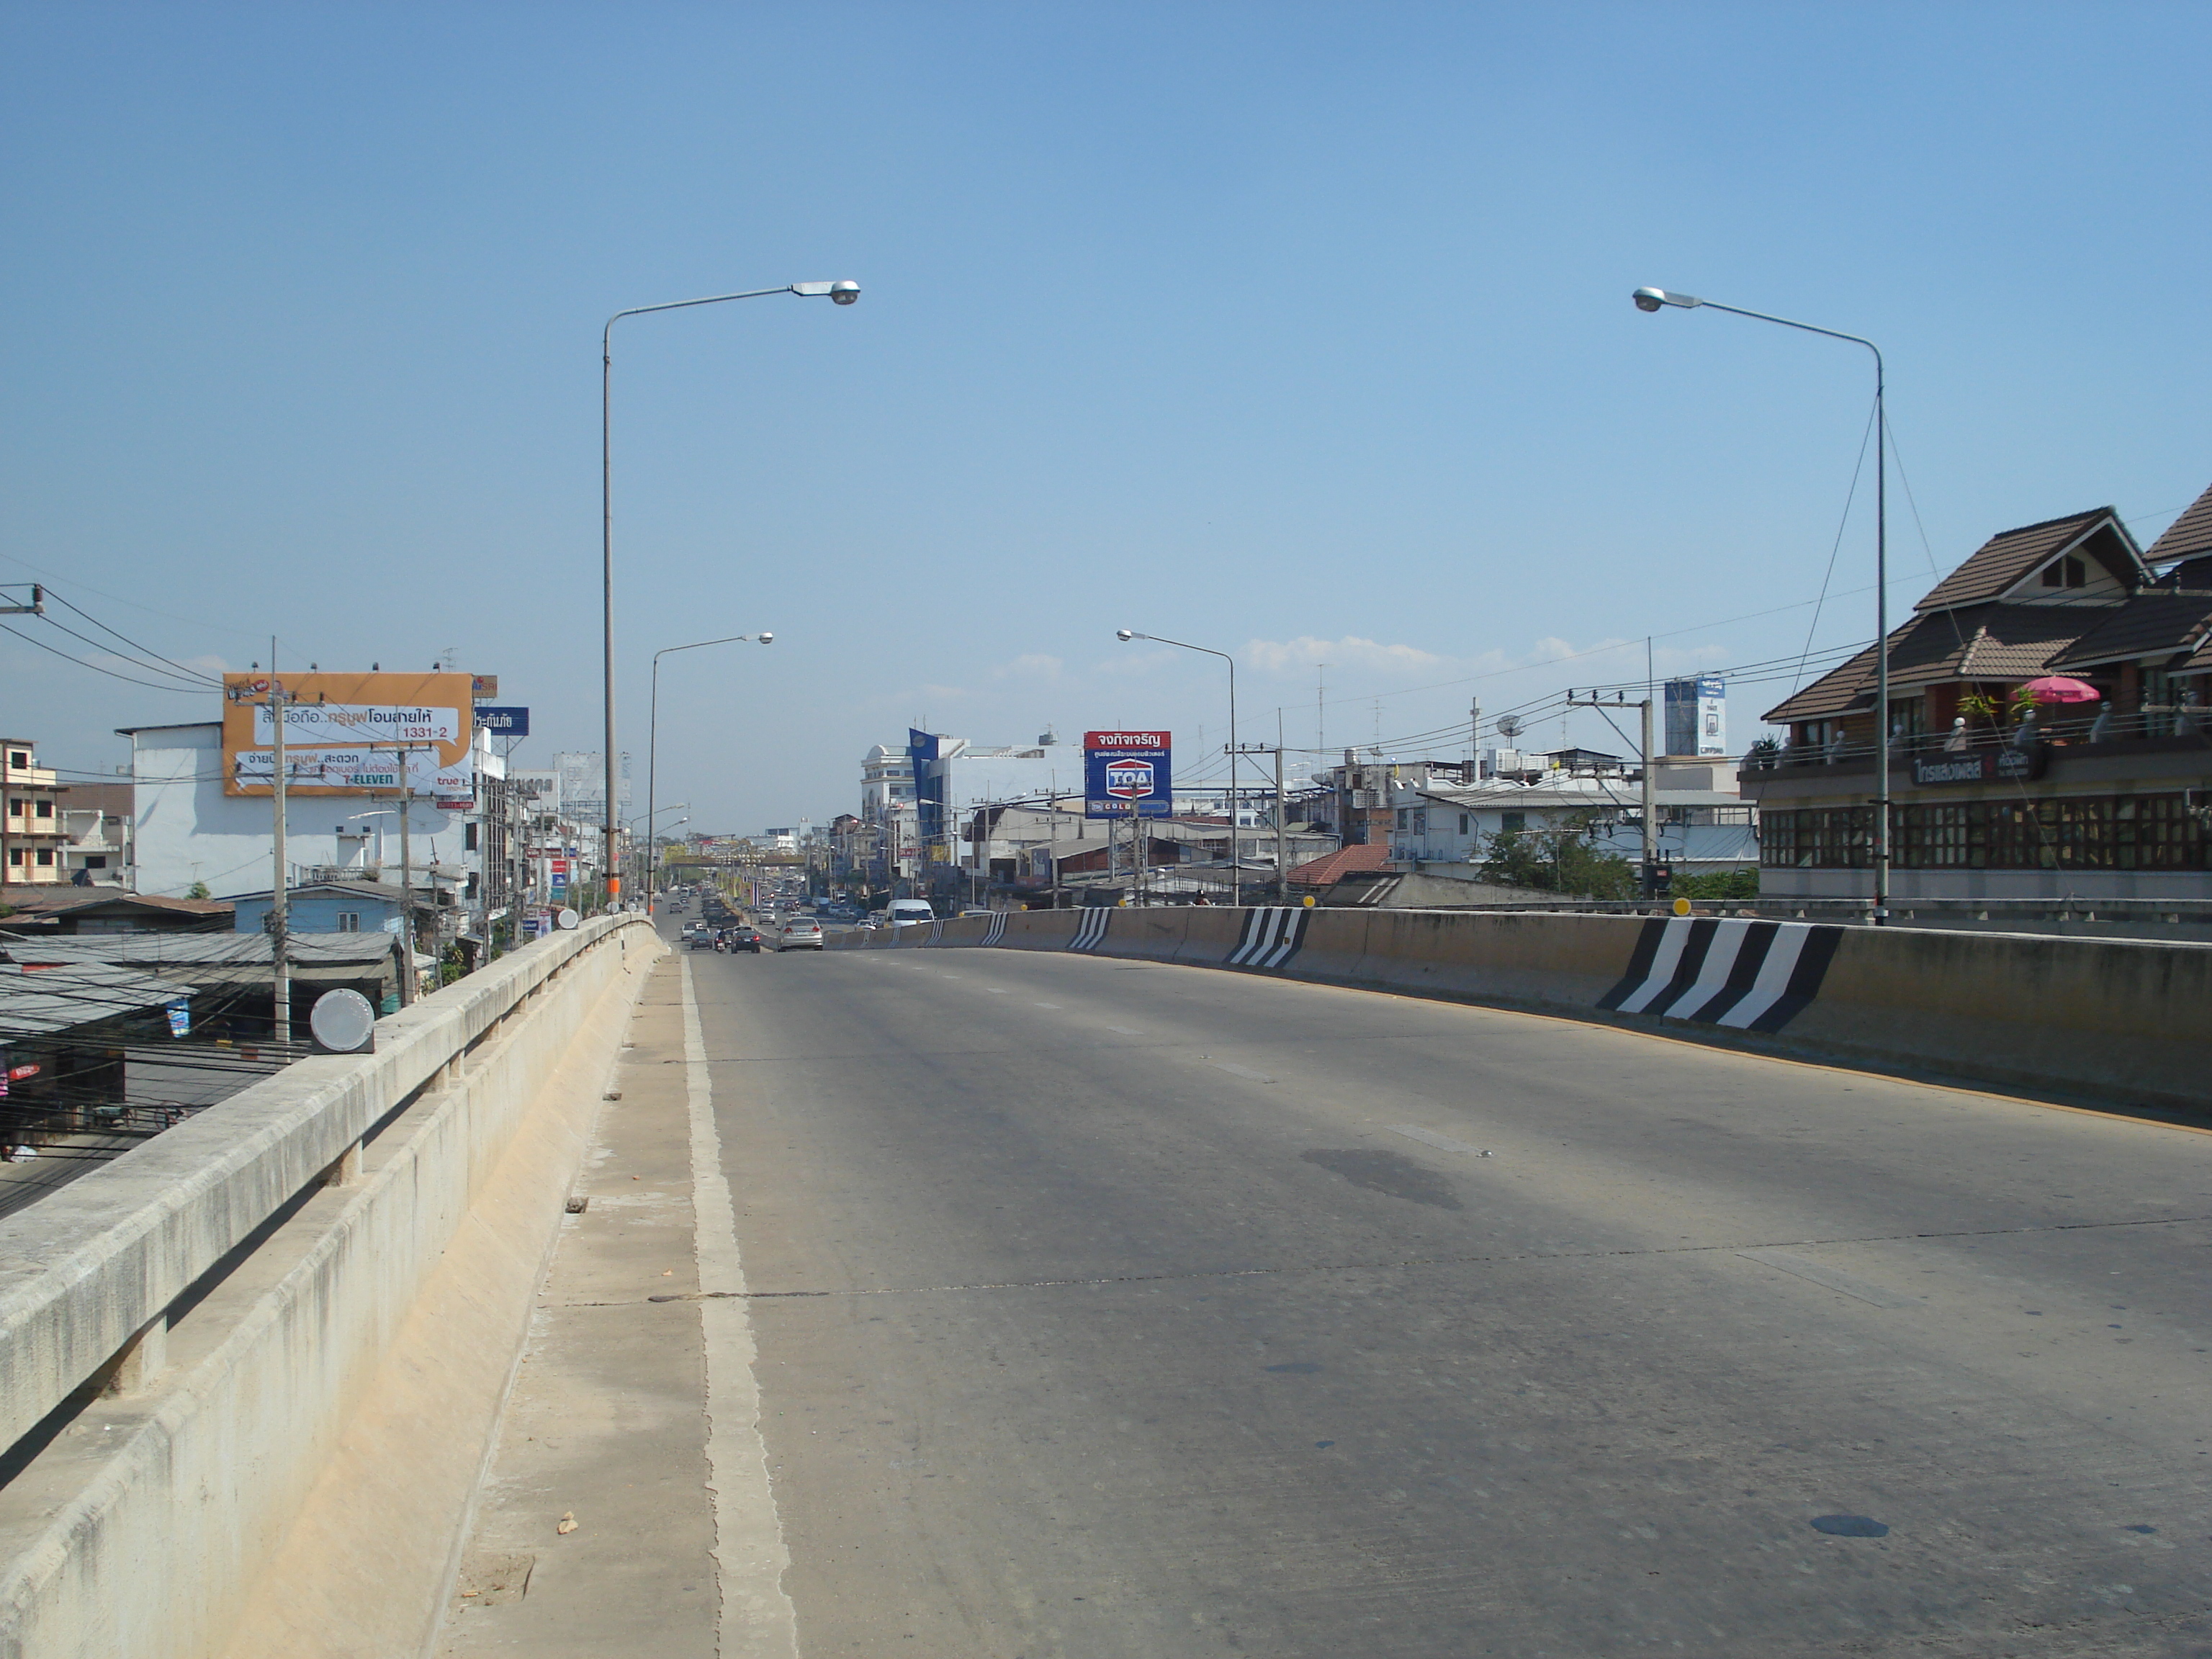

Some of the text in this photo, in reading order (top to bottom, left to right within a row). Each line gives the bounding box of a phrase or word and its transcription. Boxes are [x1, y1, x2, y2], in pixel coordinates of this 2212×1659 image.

[403, 727, 447, 738] 1331-2
[1097, 733, 1161, 747] จงกิจเจริญ
[437, 776, 459, 785] true
[1110, 771, 1150, 786] TOA
